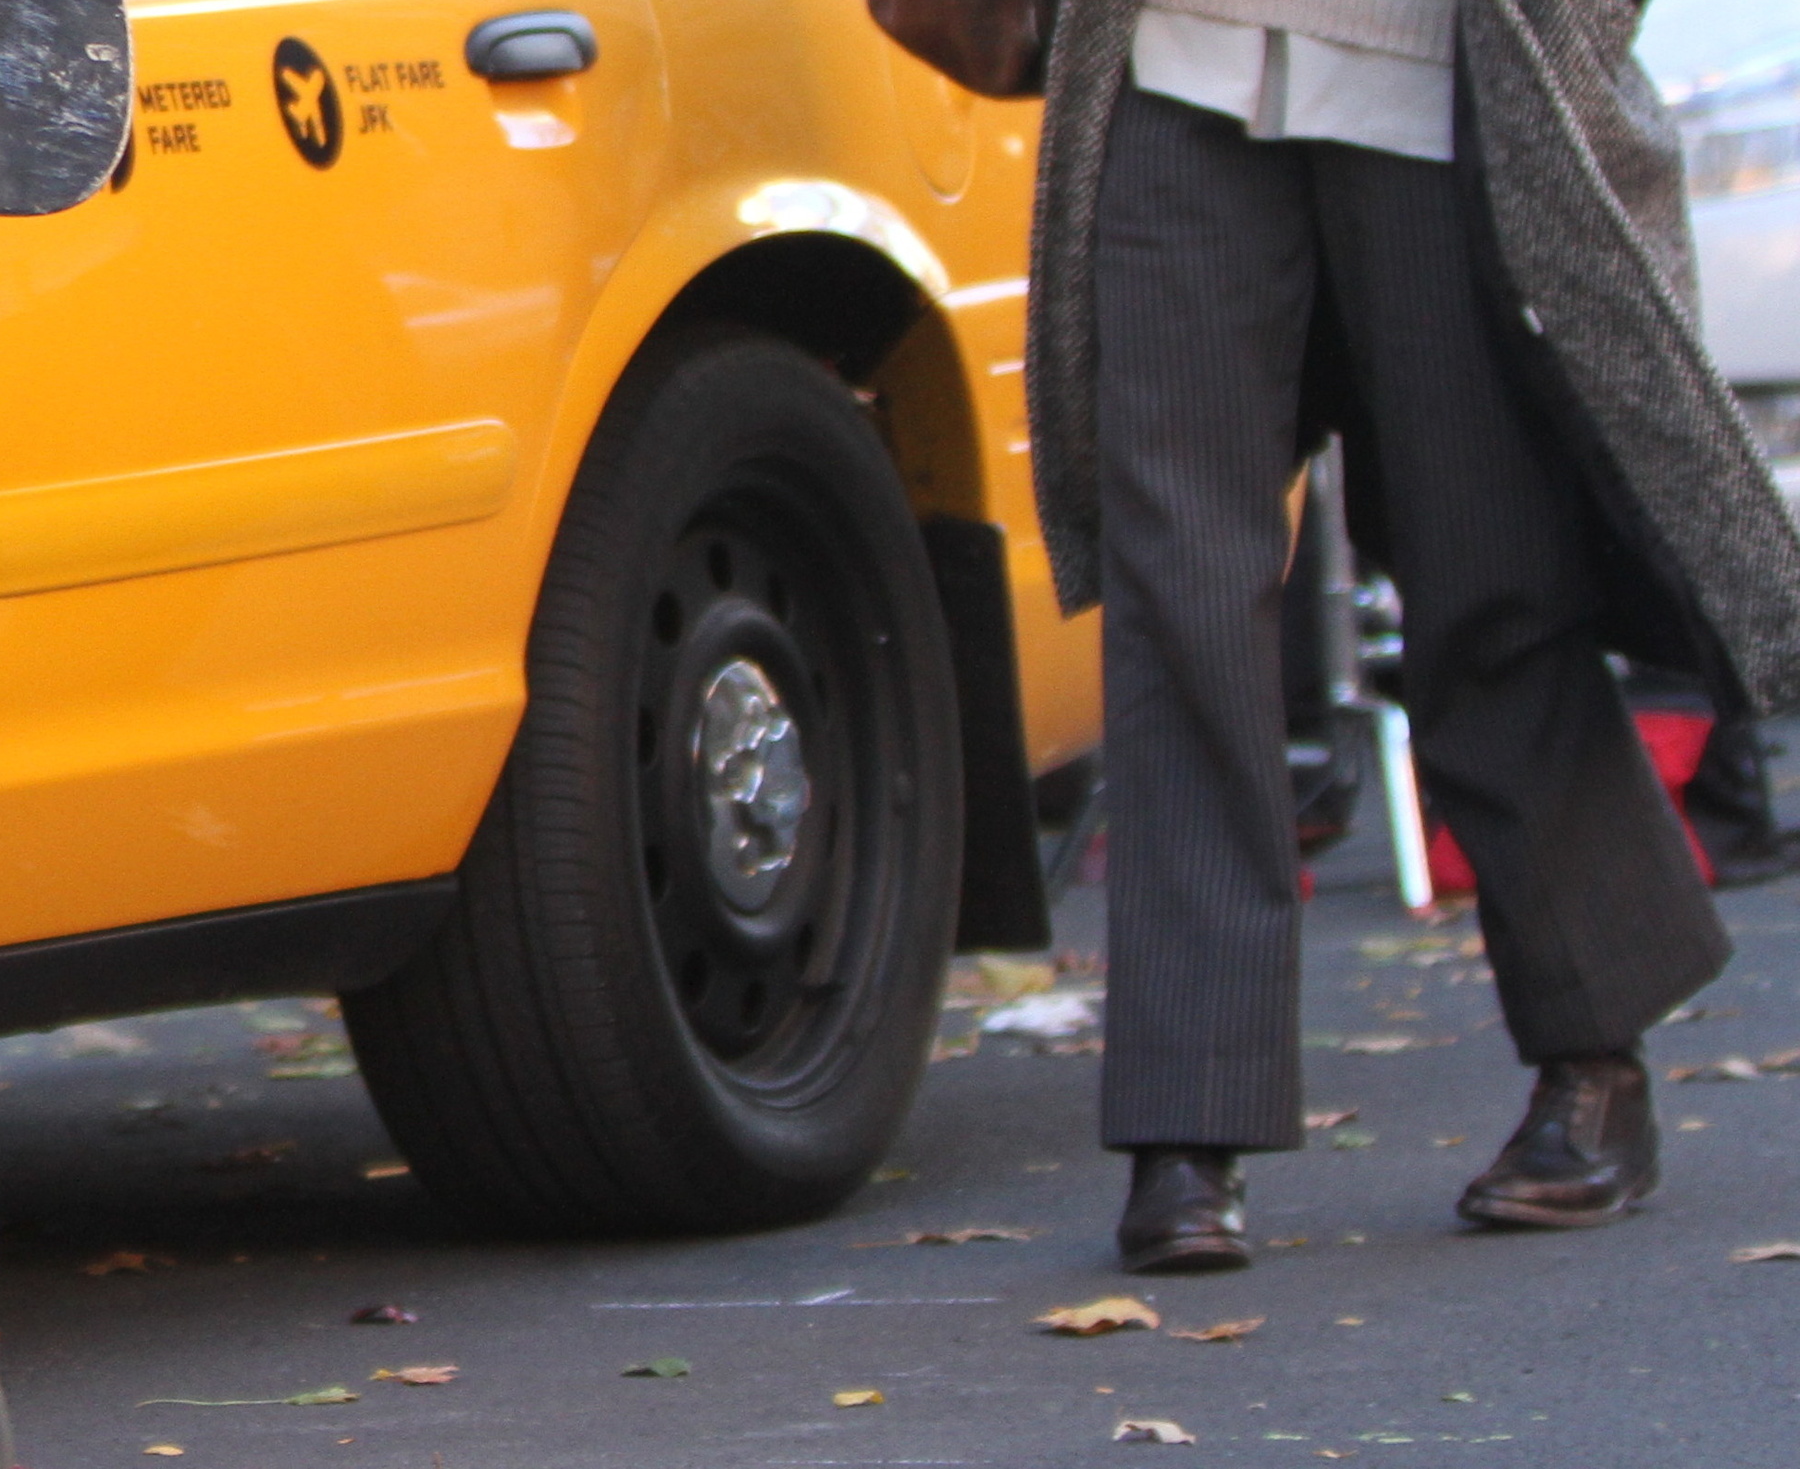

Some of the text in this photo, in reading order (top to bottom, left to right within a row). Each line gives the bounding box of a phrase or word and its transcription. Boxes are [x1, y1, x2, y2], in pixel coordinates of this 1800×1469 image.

[344, 60, 446, 94] FLAT FARE
[138, 78, 232, 114] METERED
[357, 104, 394, 134] JFK
[148, 123, 201, 155] FARE
